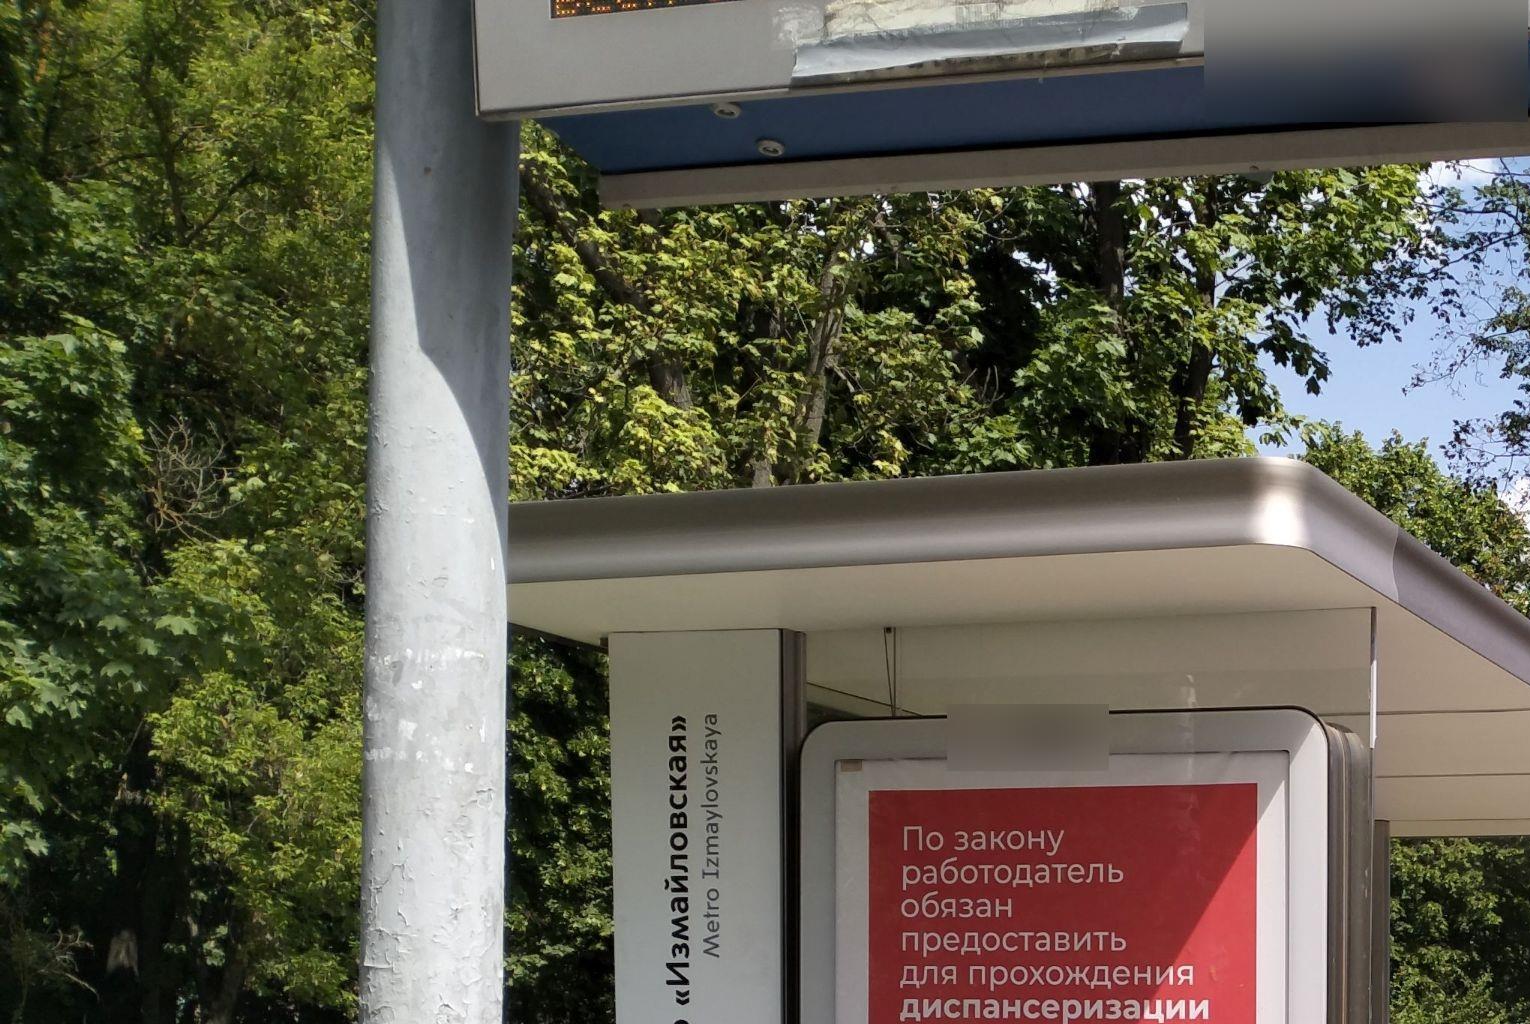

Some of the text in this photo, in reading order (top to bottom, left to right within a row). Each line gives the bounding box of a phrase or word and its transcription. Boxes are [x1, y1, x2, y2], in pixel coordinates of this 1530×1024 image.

[700, 713, 723, 958] Metro Izmaylovskaya
[903, 826, 1064, 856] По закону
[664, 714, 690, 1008] «Измайловская»
[901, 857, 1124, 890] работодатель
[900, 891, 1013, 918] обязан
[901, 930, 1127, 956] предоставить
[899, 964, 1195, 990] для прохождения
[899, 998, 1210, 1024] диспансеризации
